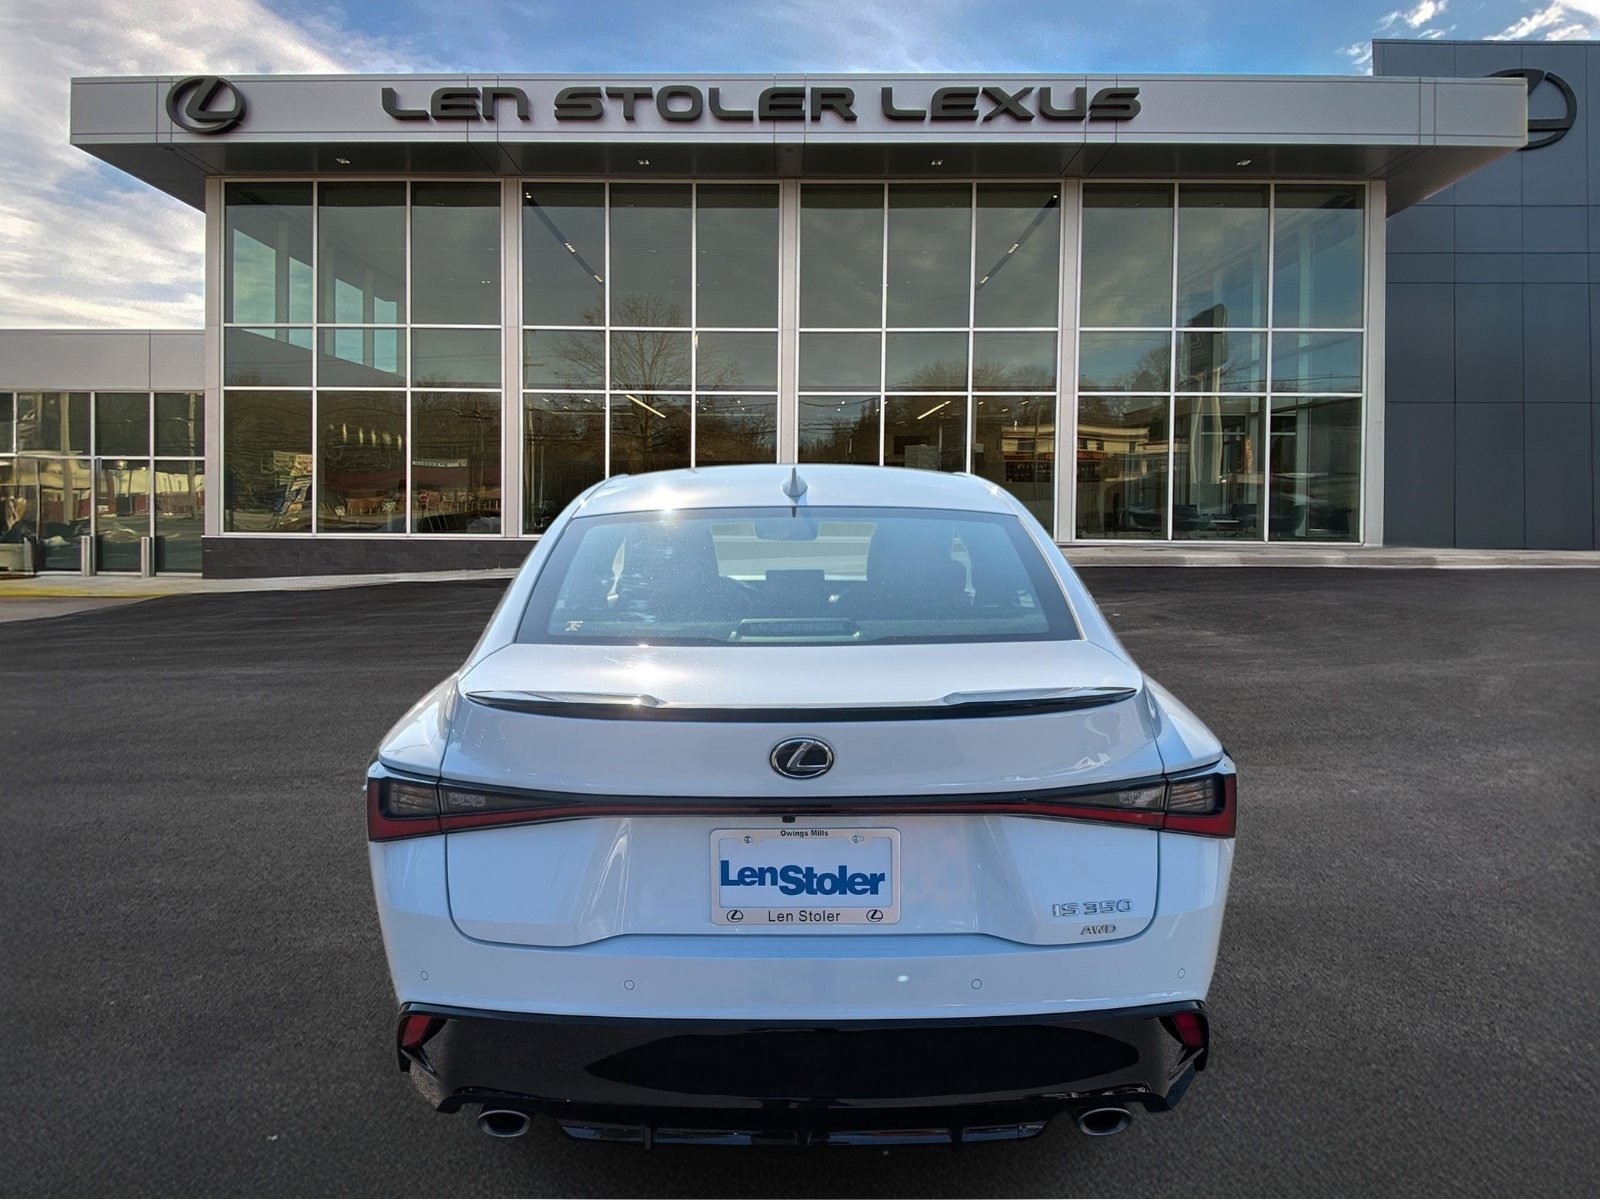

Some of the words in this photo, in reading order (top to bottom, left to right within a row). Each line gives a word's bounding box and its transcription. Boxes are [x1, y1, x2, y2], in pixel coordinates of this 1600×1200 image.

[381, 86, 530, 121] LEN
[554, 86, 858, 121] STOLER
[881, 86, 1142, 122] LEXUS
[780, 829, 809, 838] Owings
[810, 829, 829, 837] Mills
[1052, 903, 1079, 917] IS
[1083, 899, 1133, 915] 350
[768, 910, 794, 922] Len
[799, 910, 841, 922] Stoler
[1080, 924, 1117, 935] AWD
